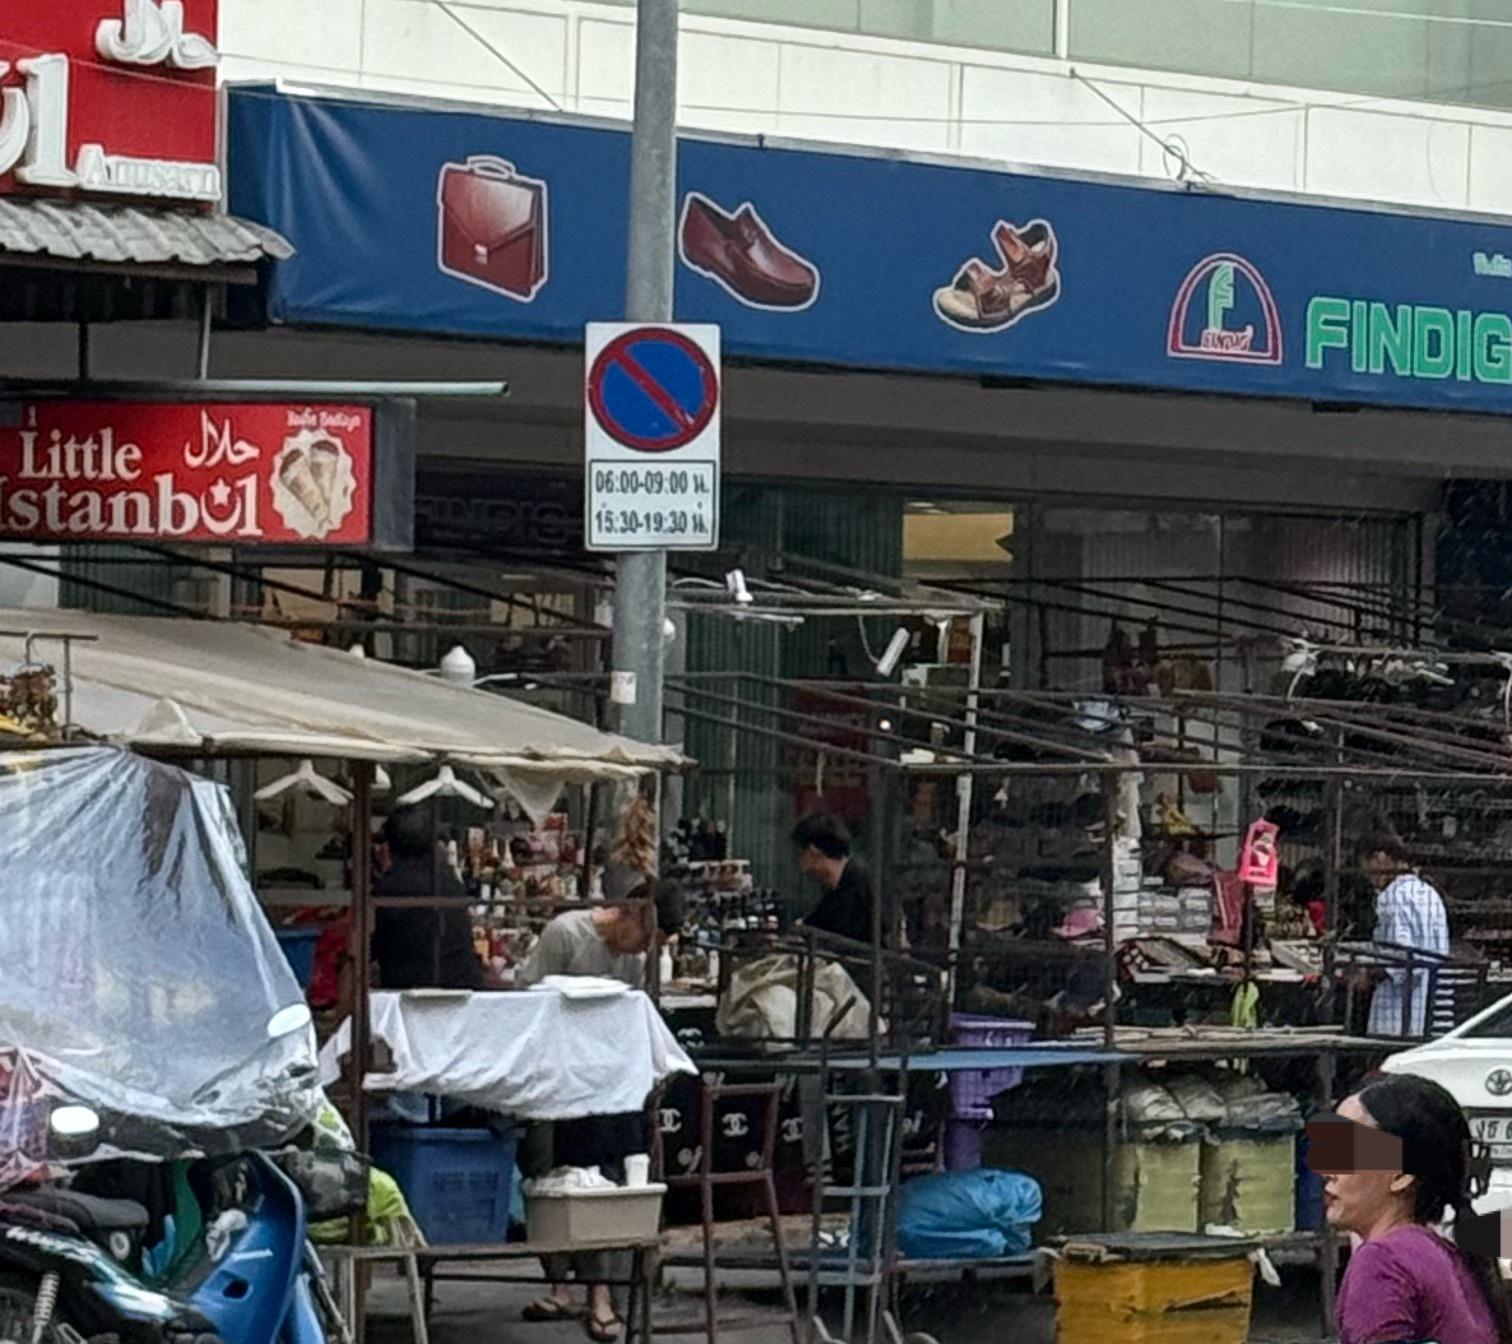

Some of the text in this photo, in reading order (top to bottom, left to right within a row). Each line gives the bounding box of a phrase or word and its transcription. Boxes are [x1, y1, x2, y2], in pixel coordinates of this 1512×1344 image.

[18, 426, 143, 481] Little
[595, 469, 688, 494] 06:00-09:00
[595, 510, 688, 534] 15:30-19:30
